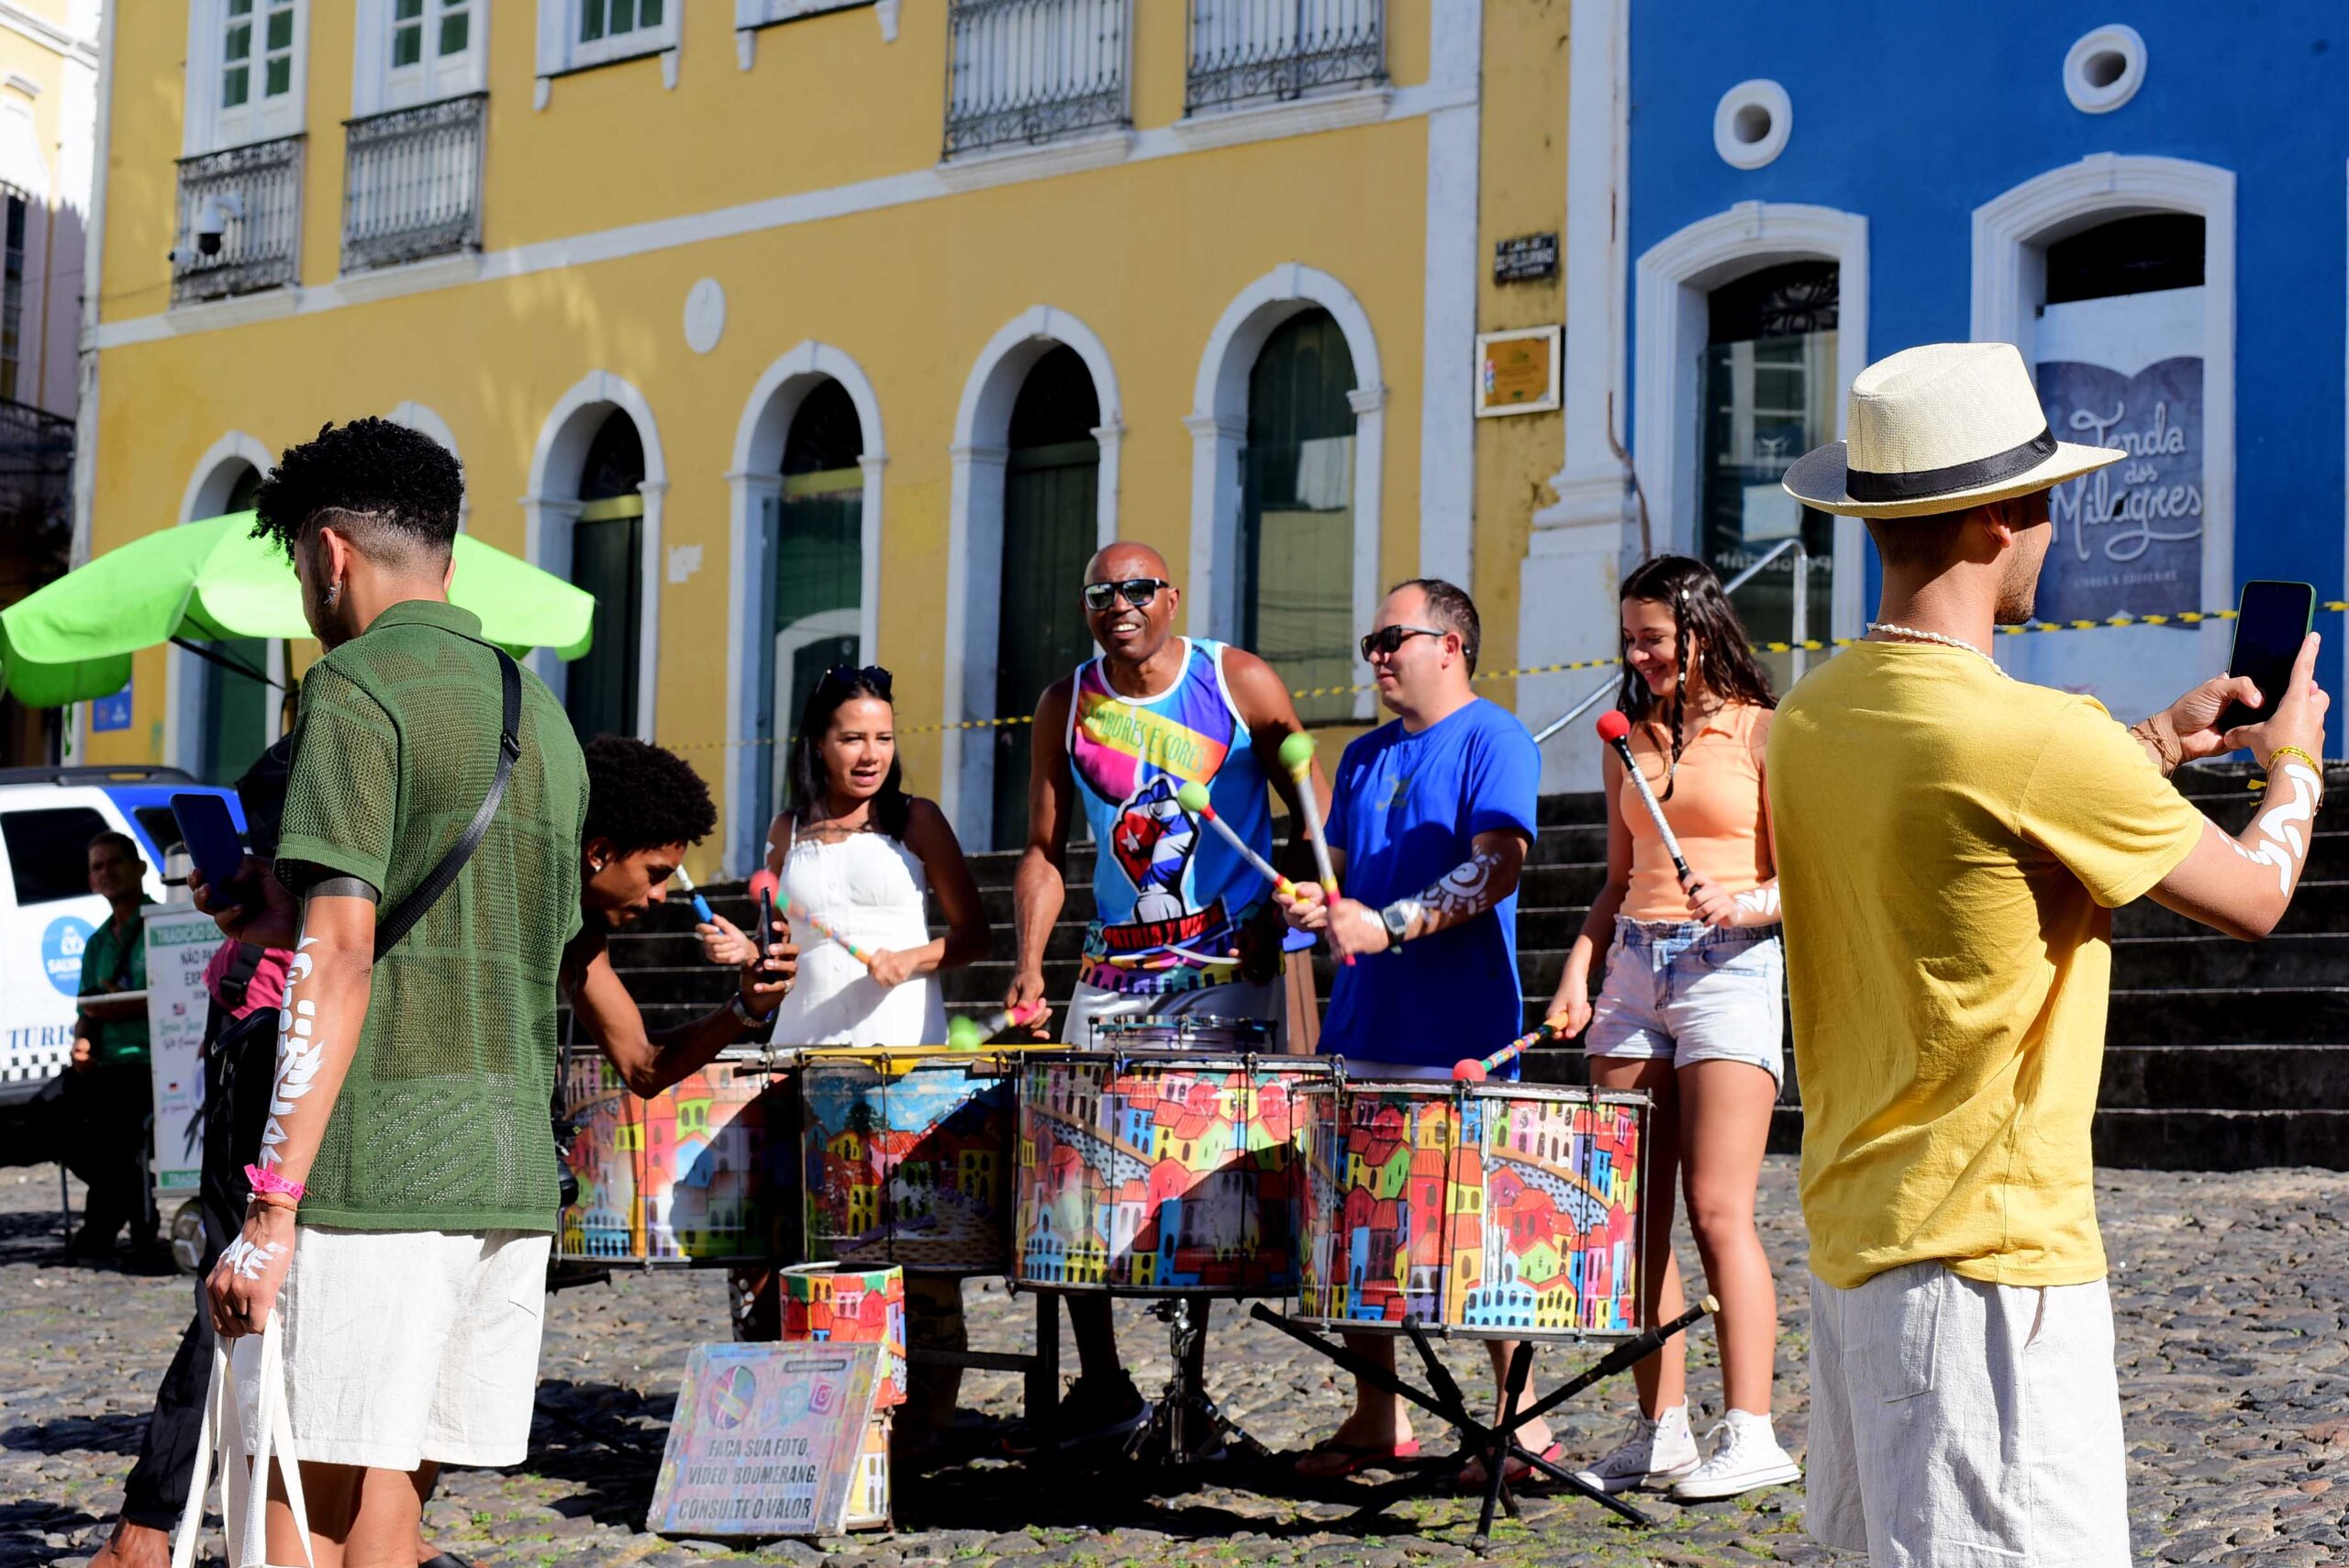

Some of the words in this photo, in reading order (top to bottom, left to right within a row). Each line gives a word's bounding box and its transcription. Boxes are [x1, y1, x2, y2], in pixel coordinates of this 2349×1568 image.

[2069, 399, 2186, 457] Tenda
[2124, 461, 2158, 485] dos
[2051, 469, 2203, 562] Milagres
[1149, 727, 1161, 753] E
[1163, 734, 1206, 771] CORES
[180, 947, 199, 964] NÃO
[184, 971, 203, 985] EXP
[744, 1439, 771, 1457] SUA
[678, 1497, 750, 1519] CONSULTE
[752, 1497, 763, 1518] O
[765, 1496, 812, 1518] VALOR
